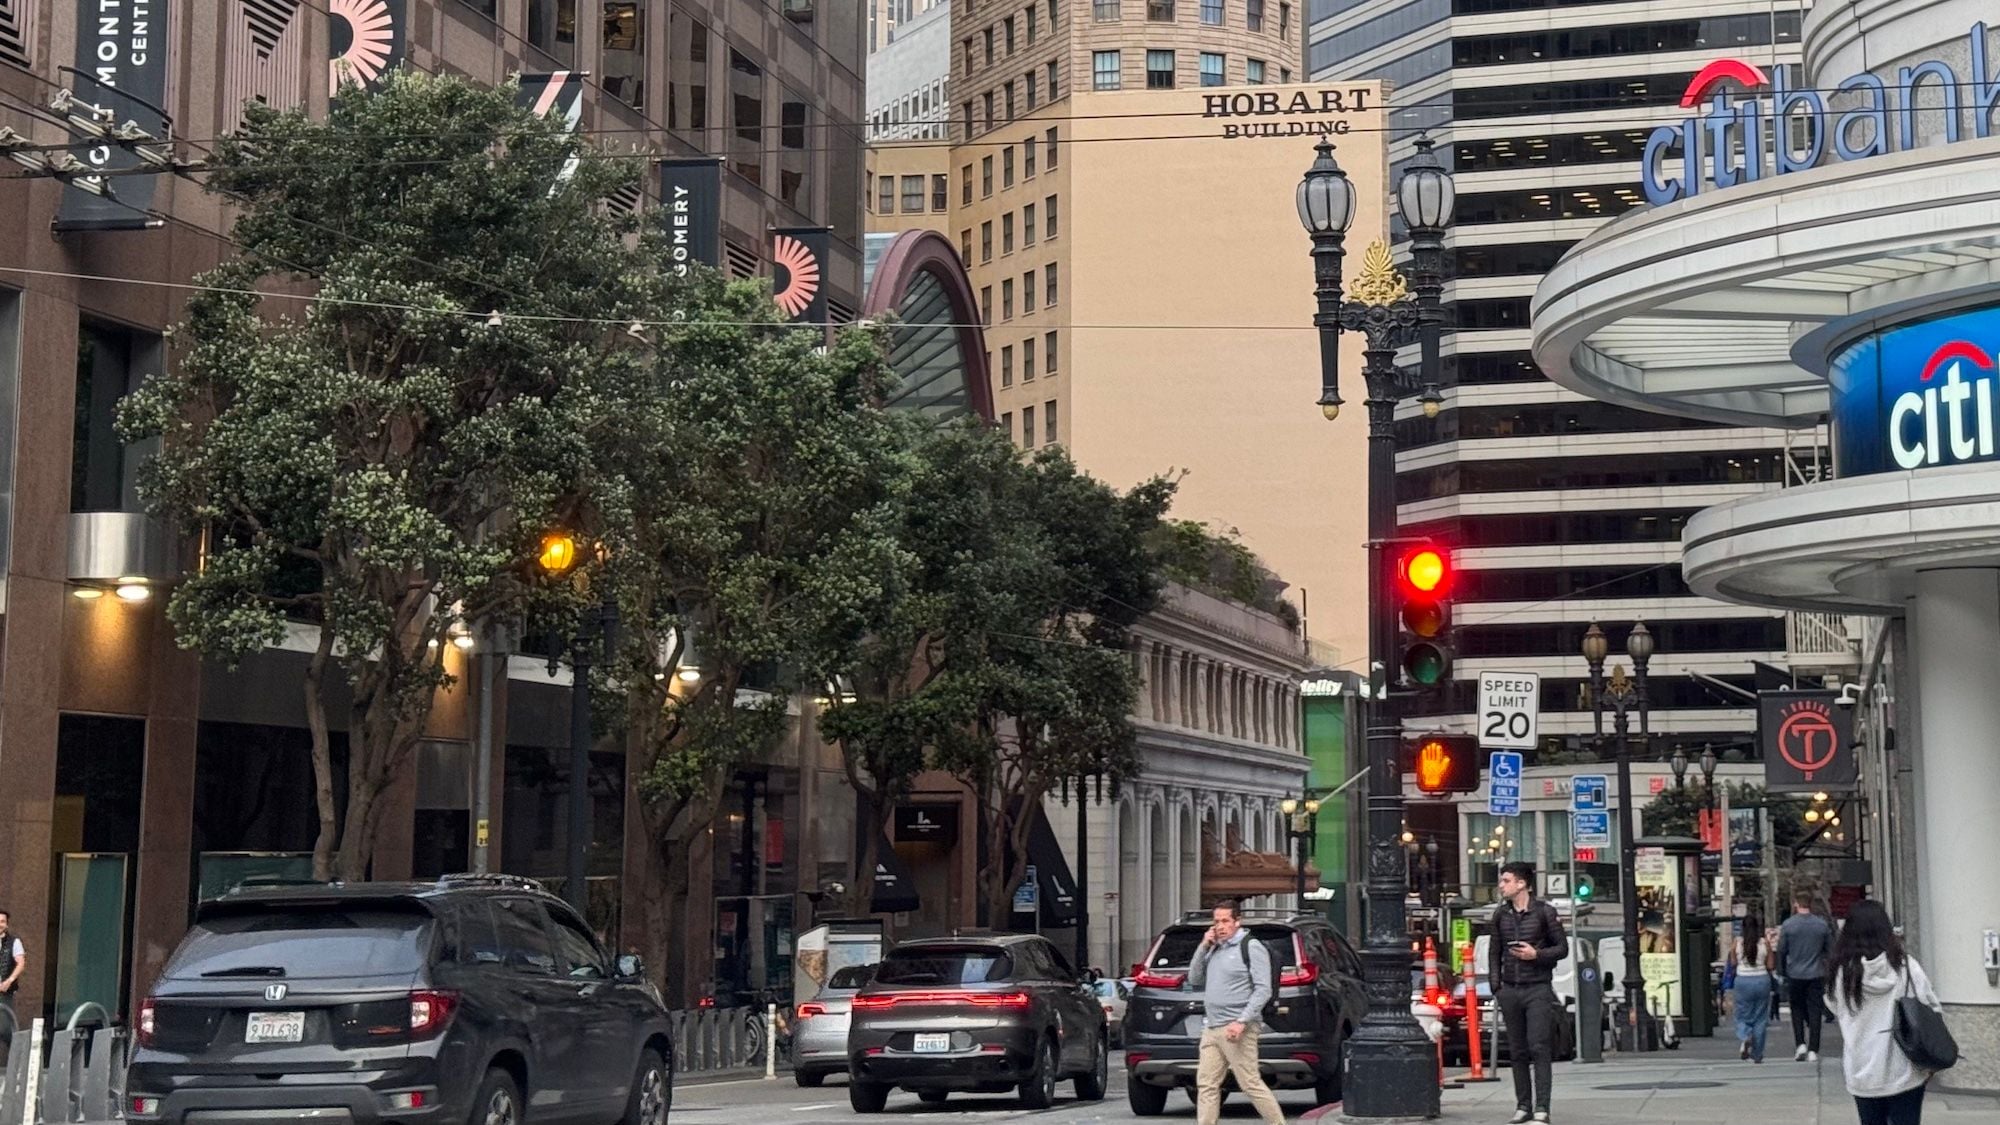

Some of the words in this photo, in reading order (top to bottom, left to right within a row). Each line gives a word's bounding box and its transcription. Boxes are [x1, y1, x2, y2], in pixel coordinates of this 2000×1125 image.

[131, 0, 149, 66] CENT
[1202, 88, 1371, 118] HOBART
[1222, 120, 1350, 139] BUILDING
[1485, 680, 1534, 692] SPEED
[1489, 695, 1528, 708] LIMIT
[1484, 711, 1530, 739] 20
[1495, 786, 1514, 796] ONLY
